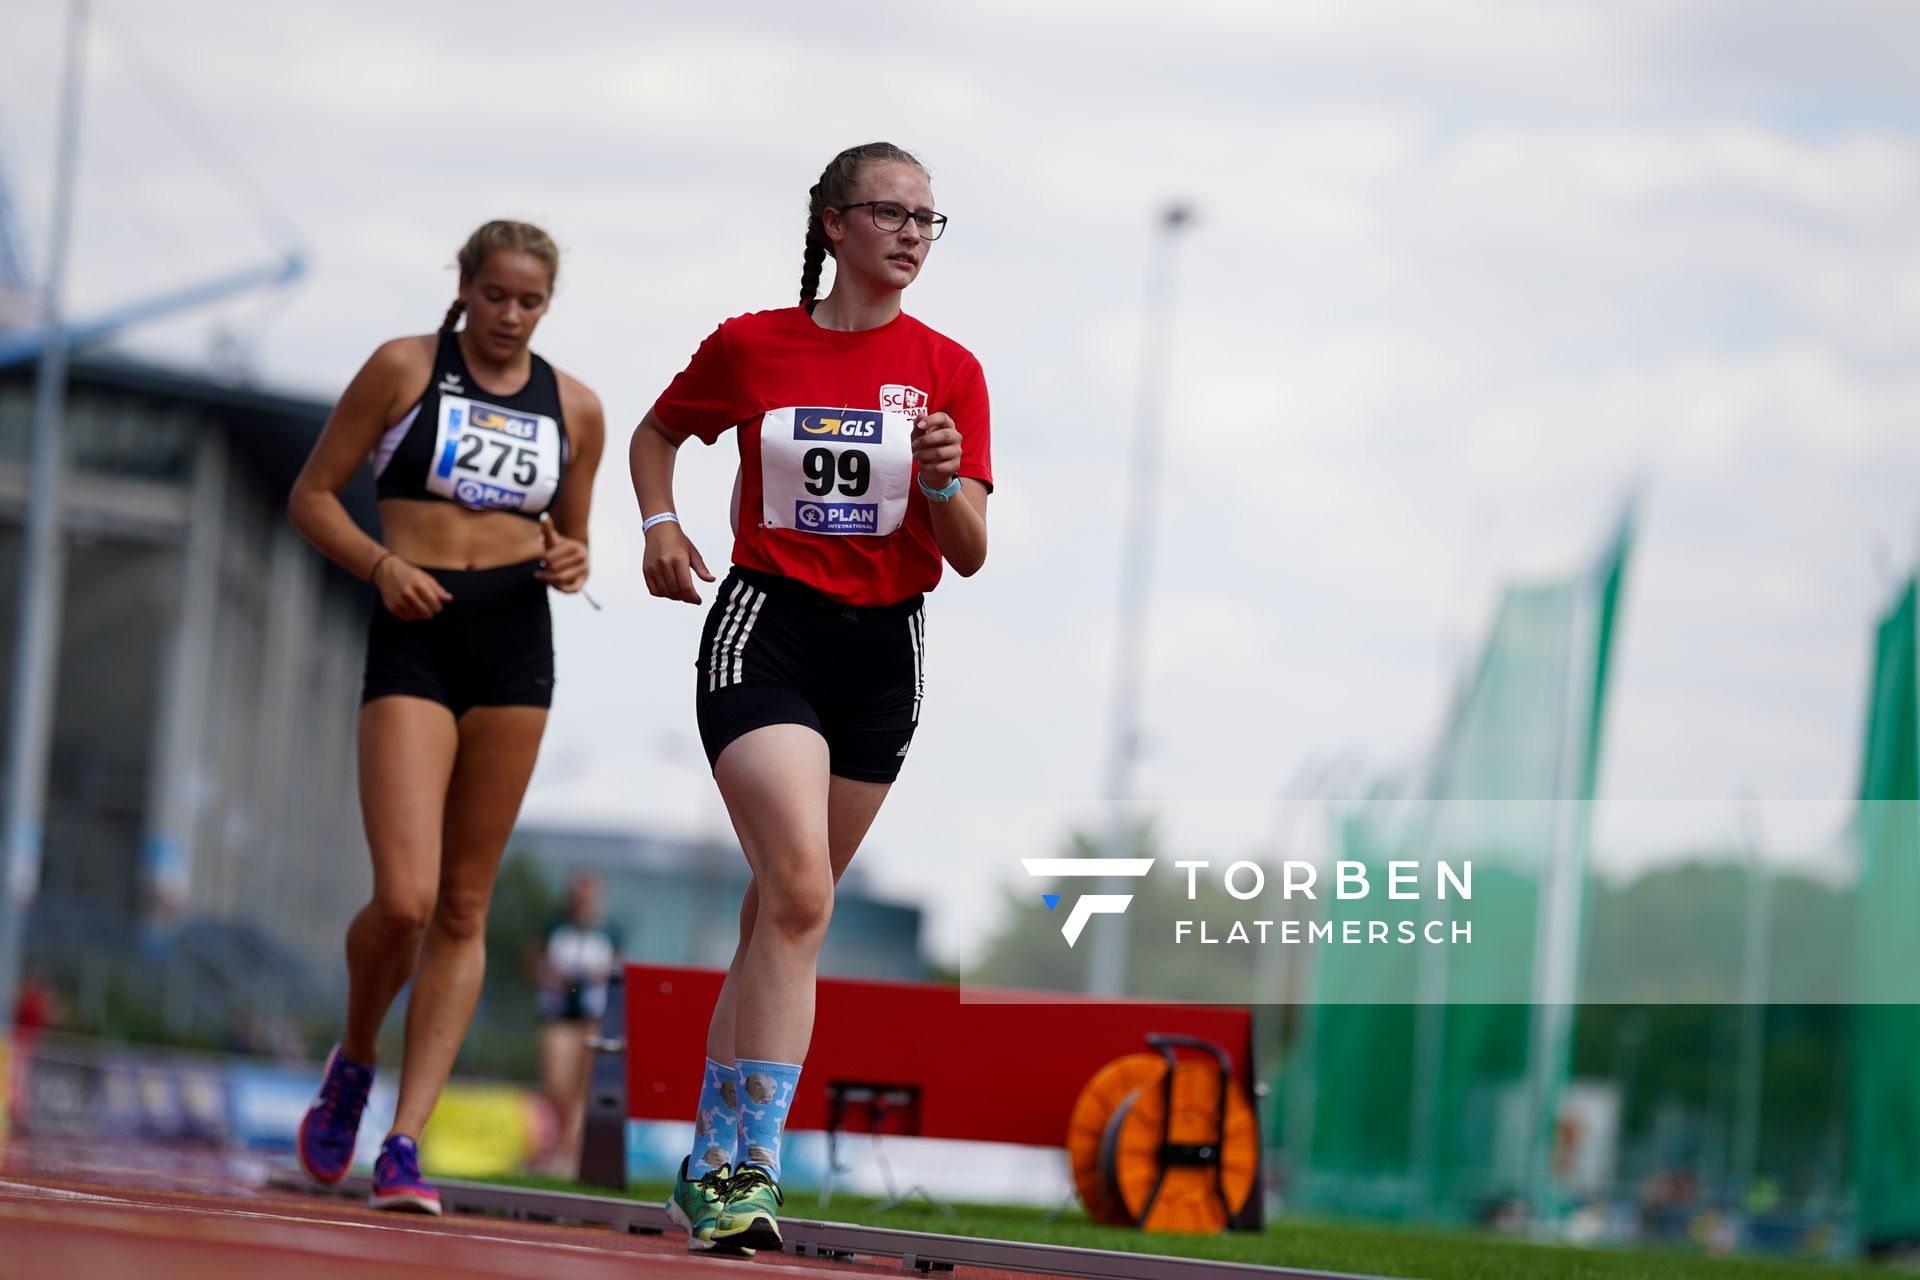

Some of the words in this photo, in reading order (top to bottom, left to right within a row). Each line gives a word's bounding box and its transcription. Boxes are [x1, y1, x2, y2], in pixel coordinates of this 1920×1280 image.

[883, 394, 902, 407] SC
[840, 420, 875, 437] GLS
[456, 434, 539, 487] 275
[802, 447, 871, 497] 99
[828, 508, 874, 523] PLAN
